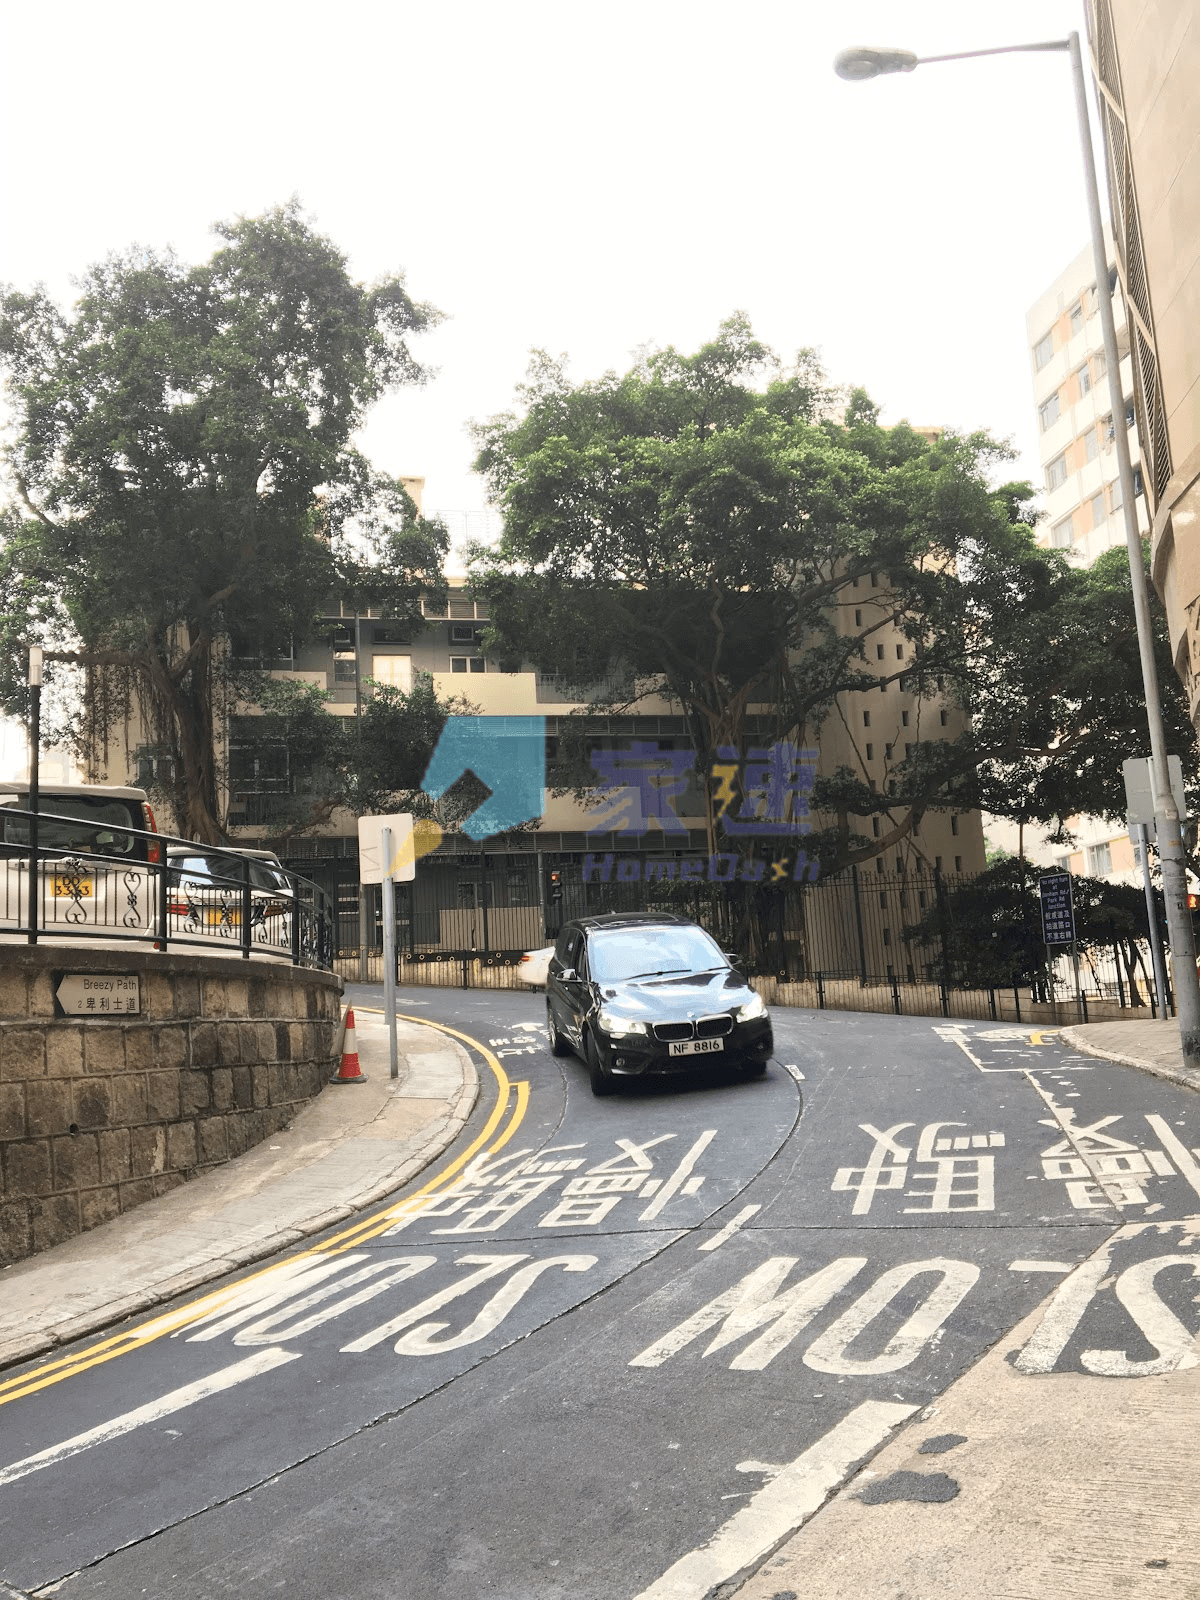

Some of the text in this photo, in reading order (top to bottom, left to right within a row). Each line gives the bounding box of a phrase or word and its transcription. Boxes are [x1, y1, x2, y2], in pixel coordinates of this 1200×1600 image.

[55, 886, 90, 896] 333
[83, 979, 137, 992] Breezy Path
[77, 997, 136, 1011] 2 卑利士道
[673, 1040, 720, 1054] NF 8816
[128, 1253, 598, 1356] SLOW
[628, 1253, 1200, 1378] SLOW
